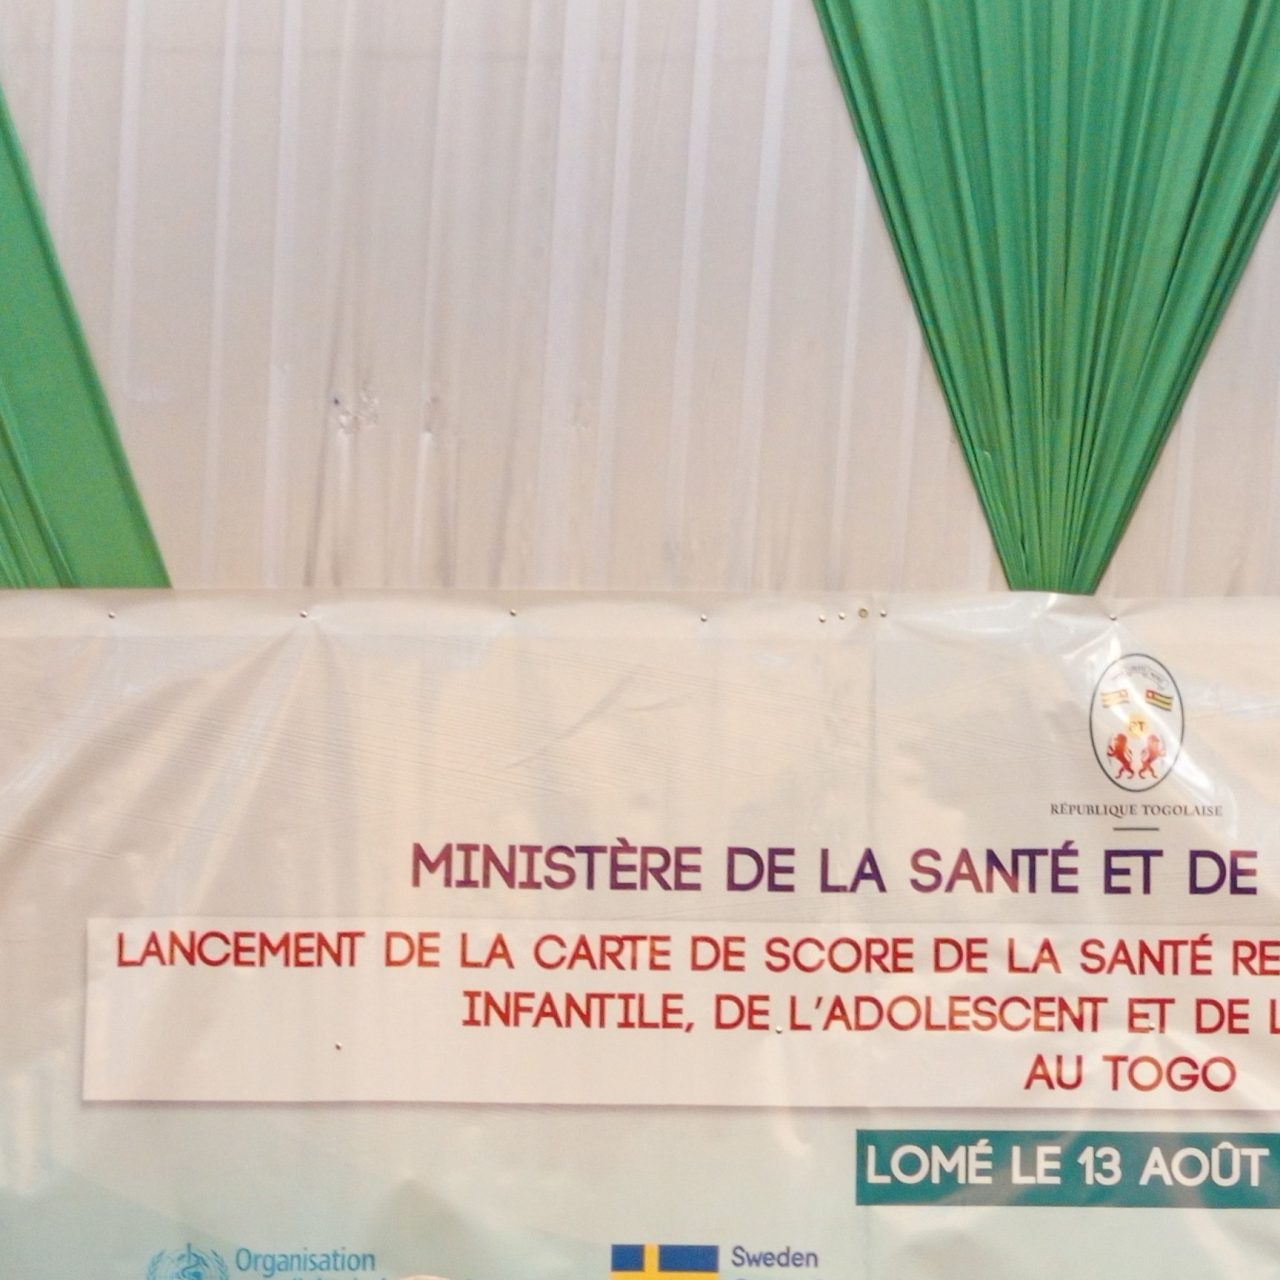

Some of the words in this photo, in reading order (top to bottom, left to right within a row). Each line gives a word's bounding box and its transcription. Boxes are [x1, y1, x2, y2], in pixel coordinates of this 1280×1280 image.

[1050, 802, 1138, 819] RÉPUBLIQUE
[1143, 804, 1223, 817] TOGOLAISE
[412, 837, 702, 891] MINISTÈRE
[727, 847, 795, 892] DE
[820, 848, 887, 893] LA
[910, 840, 1079, 894] SANTÉ
[1104, 849, 1163, 895] ET
[1189, 850, 1257, 895] DE
[117, 931, 365, 967] LANCEMENT
[385, 932, 440, 967] DE
[460, 933, 514, 969] LA
[534, 934, 671, 971] CARTE
[691, 936, 745, 972] DE
[765, 937, 914, 973] SCORE
[934, 938, 988, 973] DE
[1008, 938, 1061, 973] LA
[1081, 933, 1212, 975] SANTÉ
[463, 990, 694, 1032] INFANTILE,
[715, 994, 770, 1030] DE
[1128, 998, 1175, 1034] ET
[1195, 998, 1249, 1034] DE
[1024, 1054, 1083, 1090] AU
[1103, 1055, 1236, 1092] TOGO
[866, 1139, 993, 1185] LOMÉ
[1012, 1146, 1061, 1184] LE
[1077, 1146, 1122, 1186] 13
[1139, 1141, 1270, 1187] AOÛT
[235, 1247, 375, 1278] Organisation
[731, 1246, 818, 1268] Sweden
